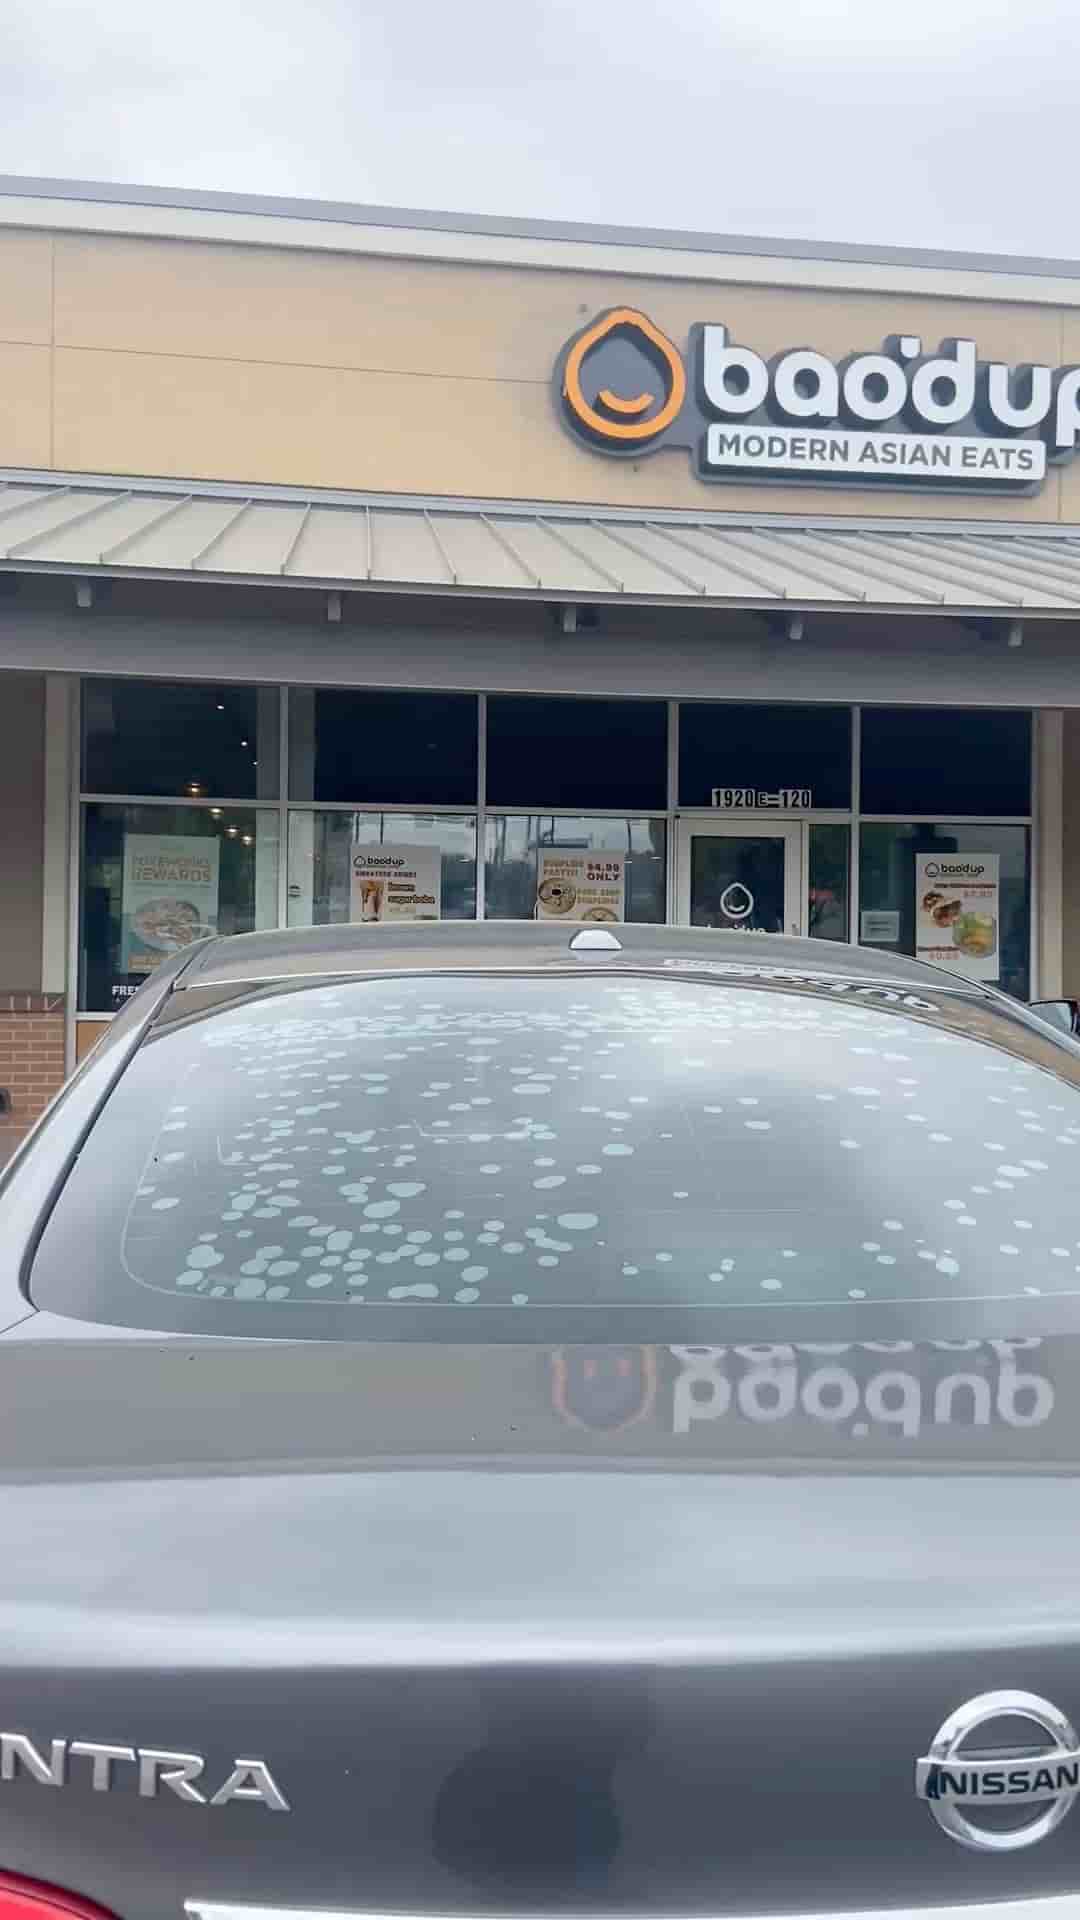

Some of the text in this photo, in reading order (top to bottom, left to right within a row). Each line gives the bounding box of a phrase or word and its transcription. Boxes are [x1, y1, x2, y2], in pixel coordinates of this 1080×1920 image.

[717, 432, 1034, 472] MODERN ASIAN EATS
[586, 872, 620, 881] ONLY
[938, 1763, 1079, 1796] NISSAN
